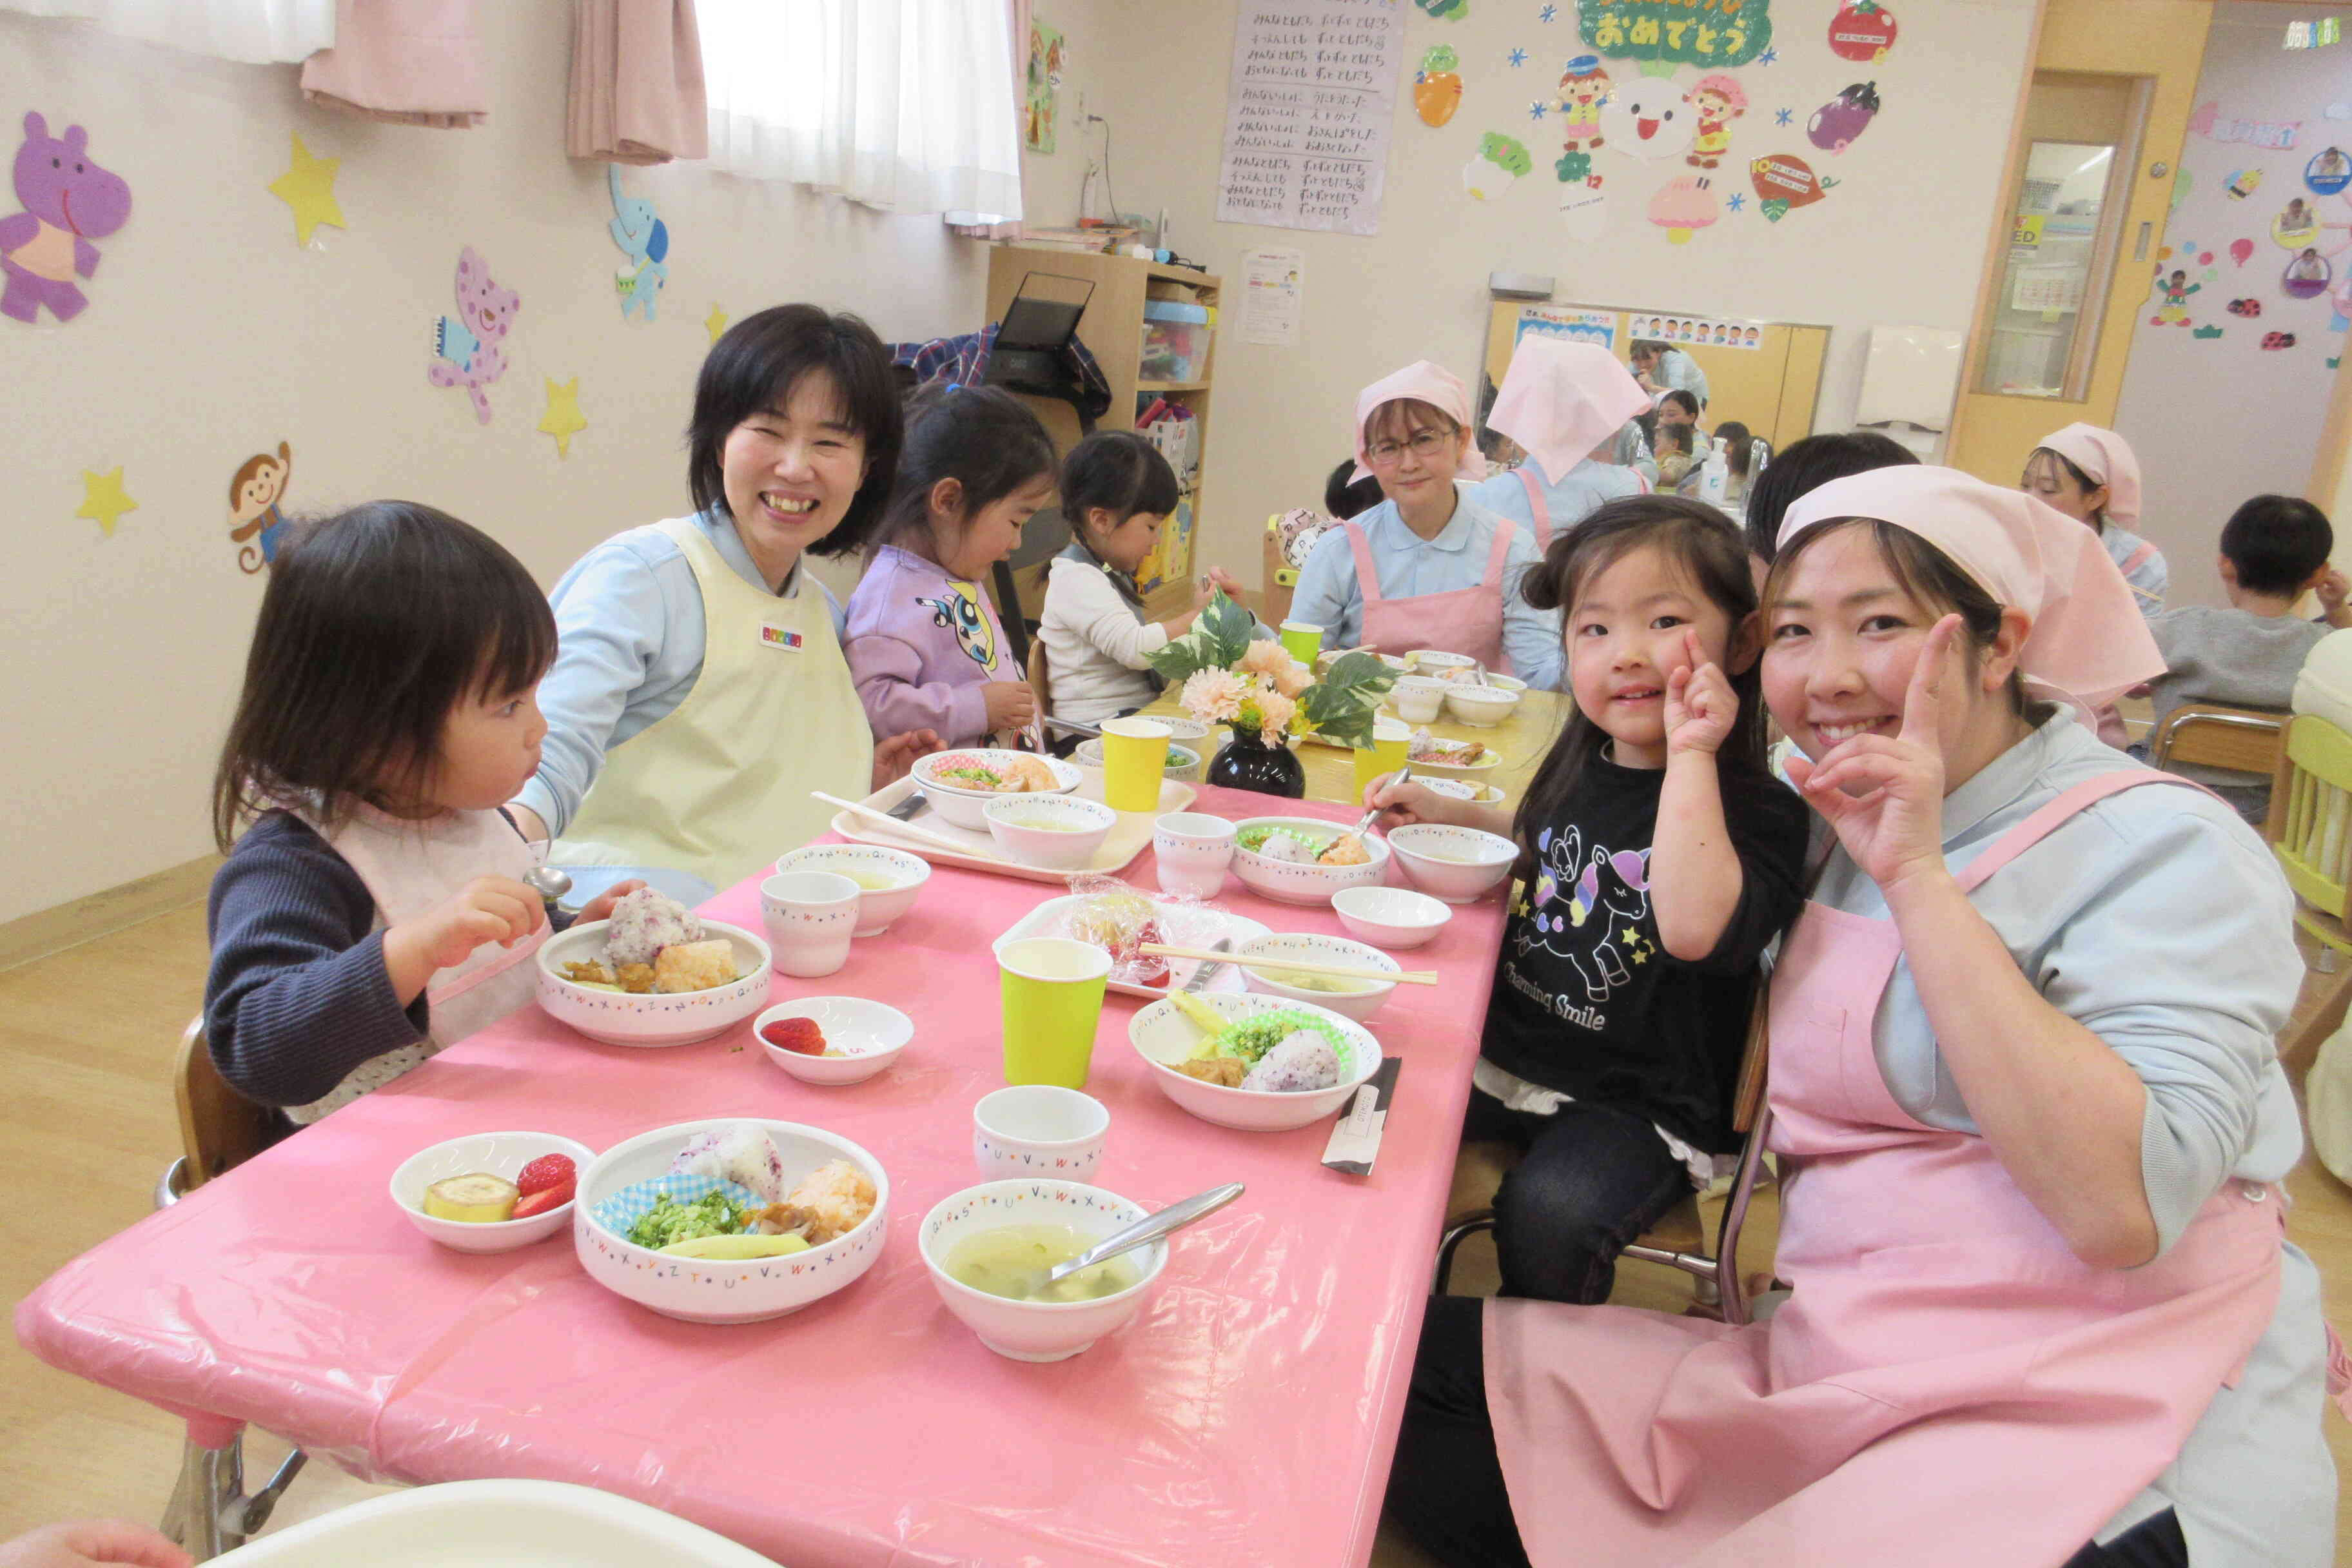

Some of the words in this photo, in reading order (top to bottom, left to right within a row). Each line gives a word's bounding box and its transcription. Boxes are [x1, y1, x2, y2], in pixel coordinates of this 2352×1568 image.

[1595, 12, 1747, 55] おめでとう
[1751, 159, 1770, 173] 10
[1587, 175, 1603, 190] 12
[2012, 230, 2035, 243] ED
[738, 988, 745, 997] Q
[1505, 961, 1553, 1013] Charming
[1555, 994, 1605, 1030] Smile
[1357, 1096, 1371, 1122] OTEMOTO
[995, 1150, 1001, 1159] U
[1024, 1155, 1031, 1164] V
[1056, 1158, 1067, 1168] W
[1088, 1150, 1093, 1162] X
[946, 1211, 952, 1222] R
[963, 1207, 969, 1217] S
[981, 1196, 989, 1207] T
[1005, 1198, 1014, 1208] U
[1032, 1186, 1039, 1197] V
[1055, 1190, 1068, 1202] W
[1085, 1196, 1093, 1206] X
[1110, 1202, 1120, 1211] Y
[1126, 1211, 1133, 1222] Z
[598, 1241, 608, 1253] W
[622, 1253, 629, 1264] X
[649, 1259, 657, 1269] Y
[670, 1266, 678, 1277] Z
[691, 1273, 700, 1282] T
[725, 1279, 735, 1289] U
[761, 1267, 769, 1278] V
[792, 1264, 805, 1275] W
[825, 1253, 834, 1265] X
